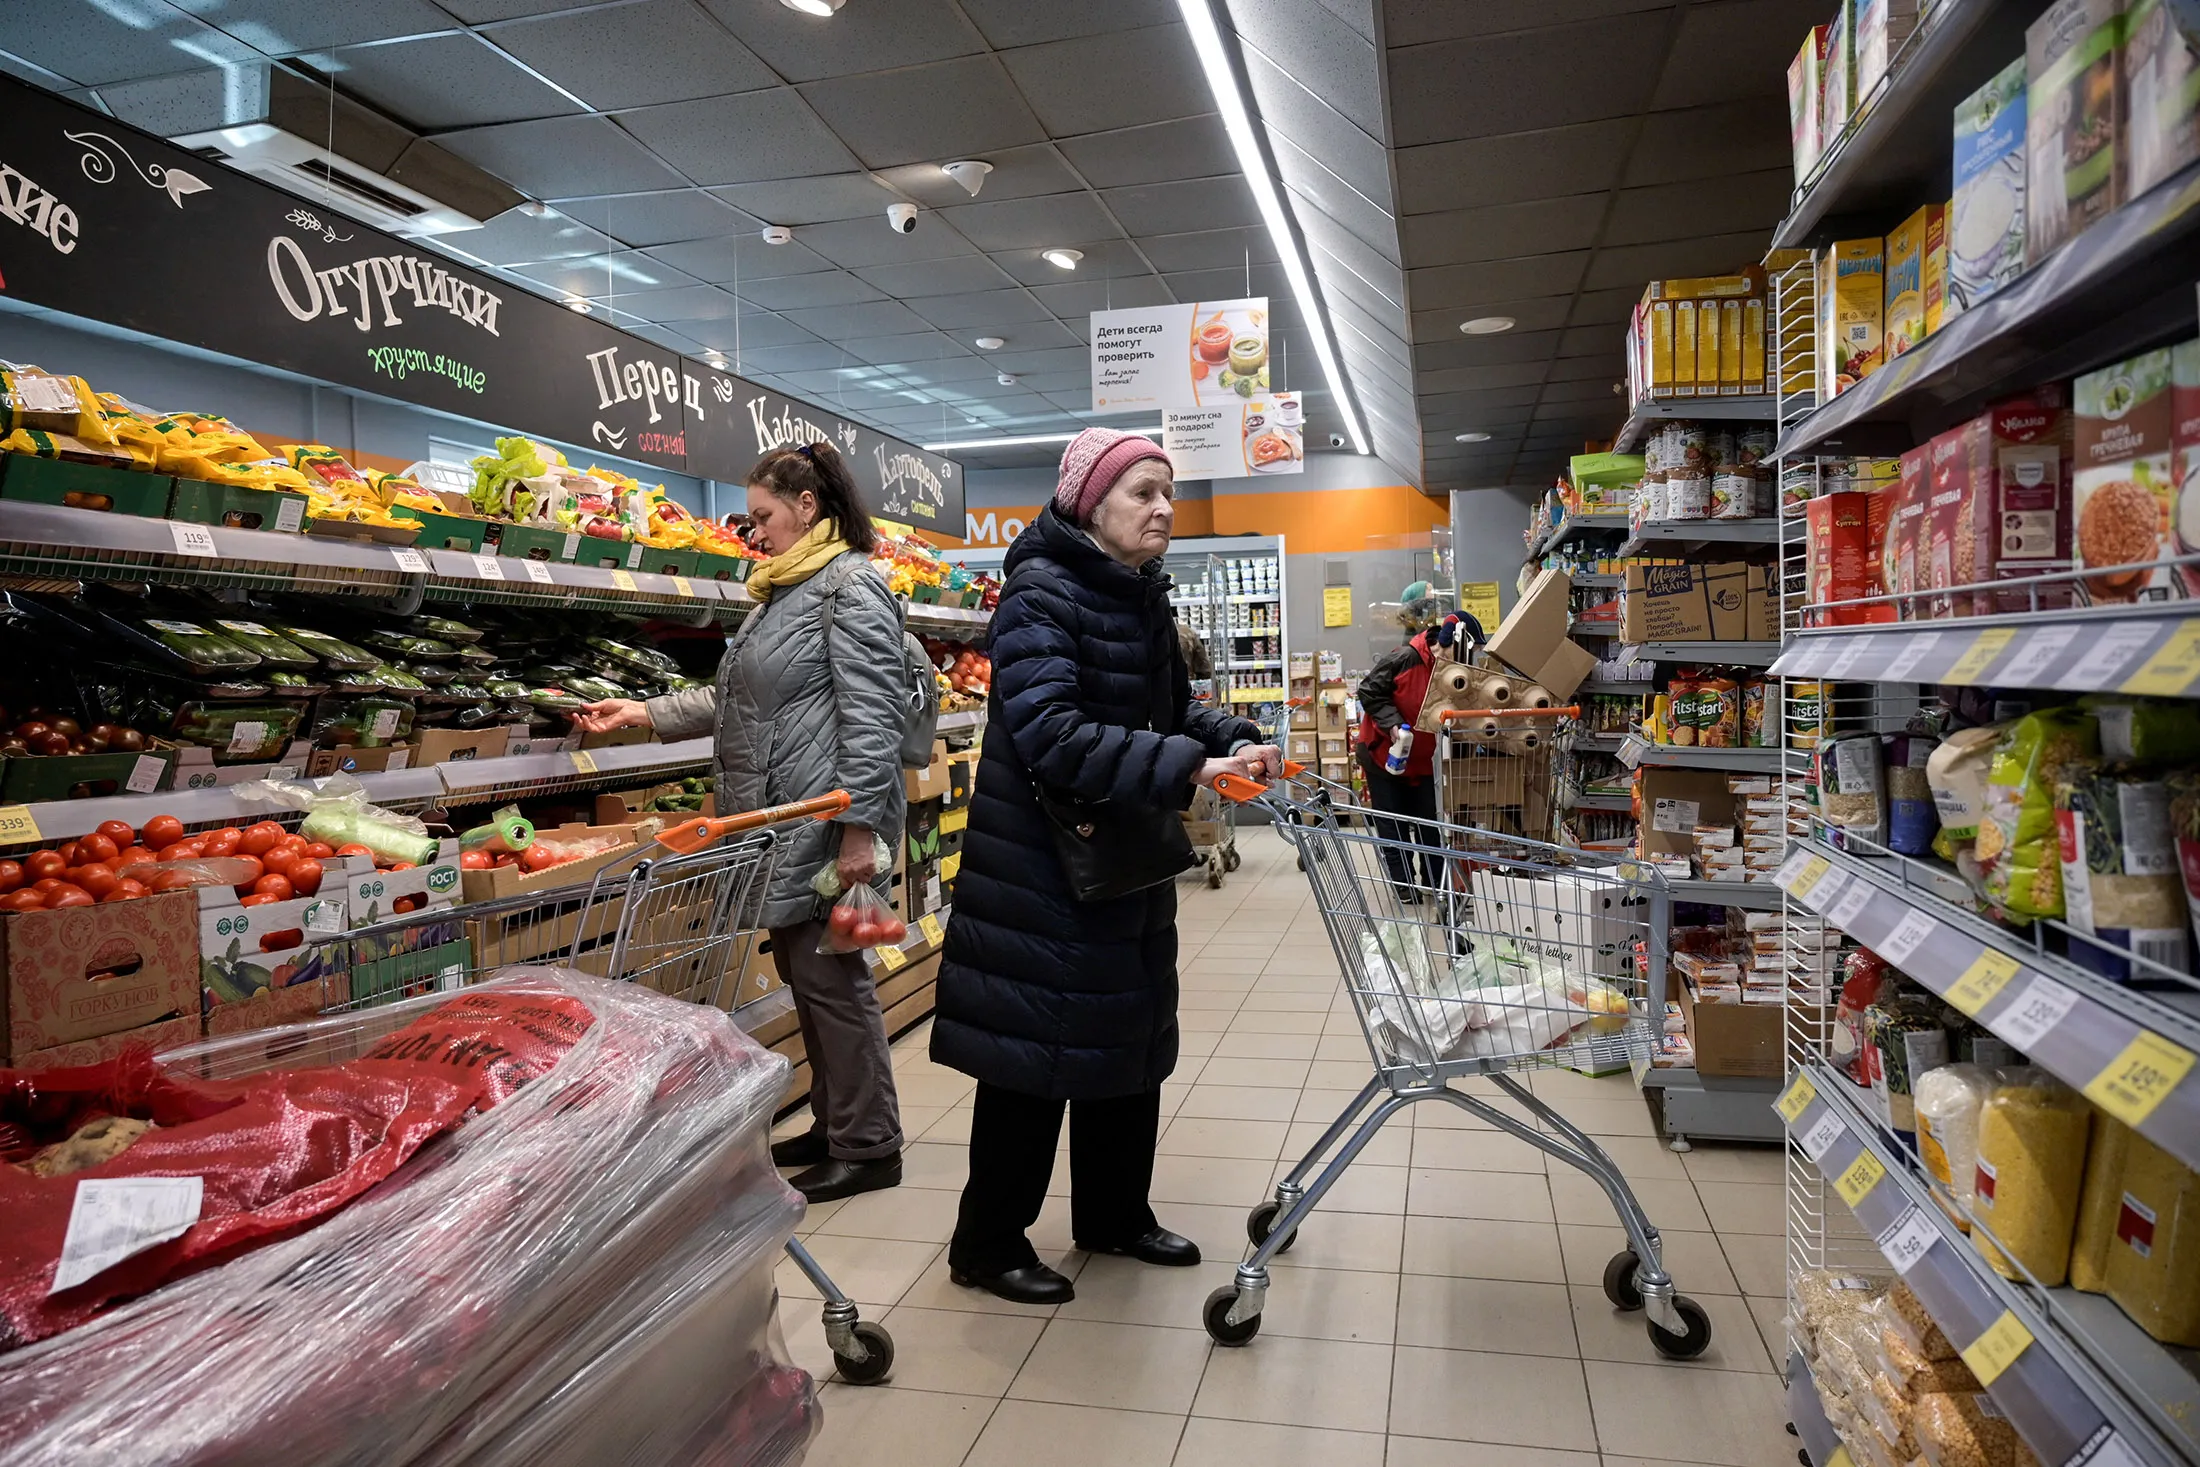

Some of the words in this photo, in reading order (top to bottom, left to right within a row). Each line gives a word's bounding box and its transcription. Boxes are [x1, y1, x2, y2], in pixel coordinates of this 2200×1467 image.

[267, 236, 503, 337] Огурчики
[1097, 327, 1125, 339] Дети
[1126, 324, 1163, 334] всегда
[1097, 339, 1142, 349] помогут
[1097, 351, 1155, 364] проверить
[367, 347, 487, 395] хрустящие
[586, 346, 705, 424] Перец
[1168, 414, 1179, 422] 30
[1180, 413, 1206, 421] минут
[746, 395, 842, 456] Кабач
[1175, 421, 1214, 431] подарок!
[638, 430, 687, 456] сочный
[2089, 432, 2145, 457] ГРЕЧНЕВАЯ
[873, 441, 945, 508] Картофель
[184, 532, 205, 543] 119
[402, 554, 417, 563] 129
[482, 562, 495, 571] 124
[1647, 566, 1690, 590] Magic
[1654, 580, 1689, 593] GRAIN
[1645, 613, 1675, 624] хлебцы?
[1646, 620, 1684, 631] Попробуй
[1647, 629, 1674, 638] MAGIC
[1675, 624, 1702, 635] GRAIN!
[1672, 700, 1698, 716] Fitst
[0, 817, 24, 830] 339
[429, 870, 456, 886] РОСТ
[70, 986, 159, 1018] ГОРКУНОВ
[2119, 1060, 2158, 1091] 149
[1851, 1164, 1869, 1187] 139
